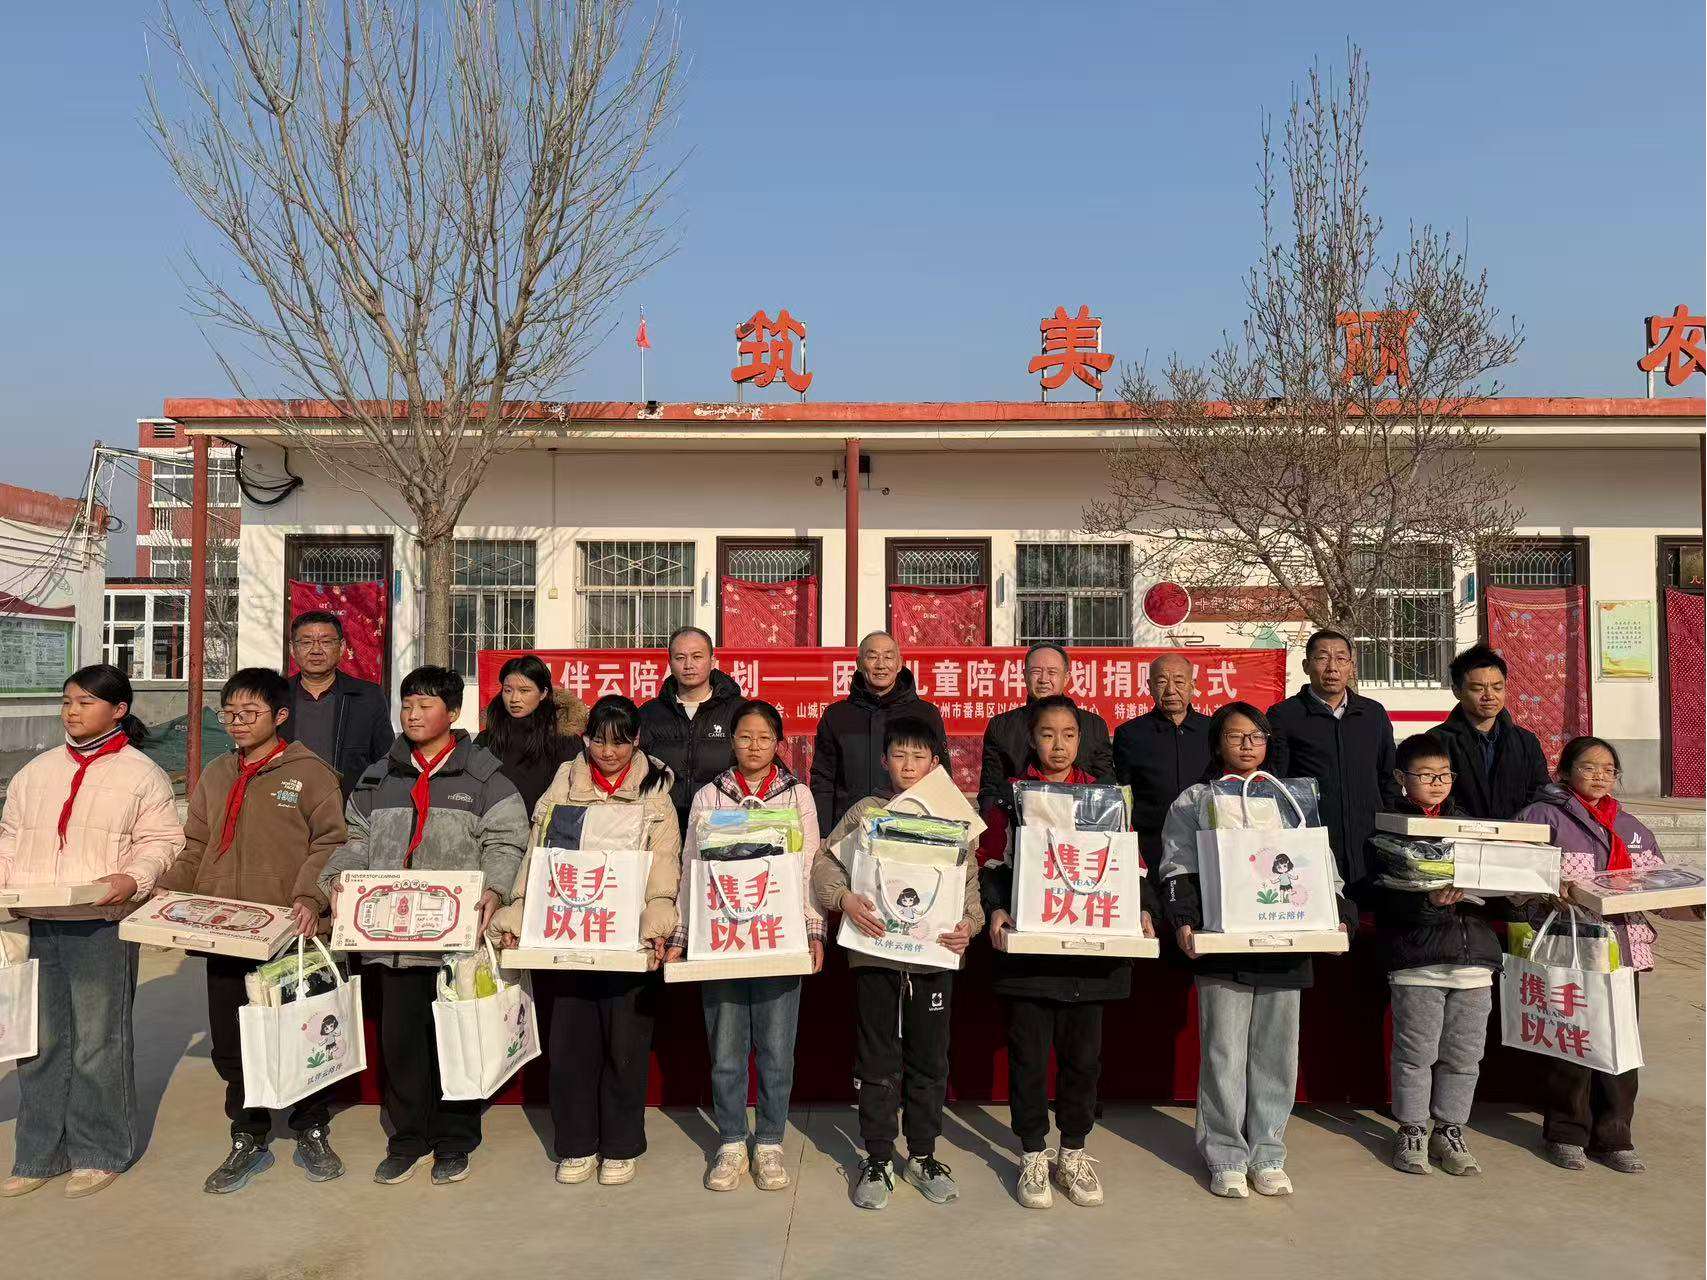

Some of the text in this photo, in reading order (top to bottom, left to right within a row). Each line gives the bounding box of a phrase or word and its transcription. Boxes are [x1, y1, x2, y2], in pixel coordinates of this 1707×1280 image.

[543, 905, 617, 943] 以伴
[1041, 888, 1120, 928] 以伴
[709, 914, 785, 952] 以伴
[1520, 971, 1588, 1018] 携手
[1520, 1012, 1592, 1059] 以伴
